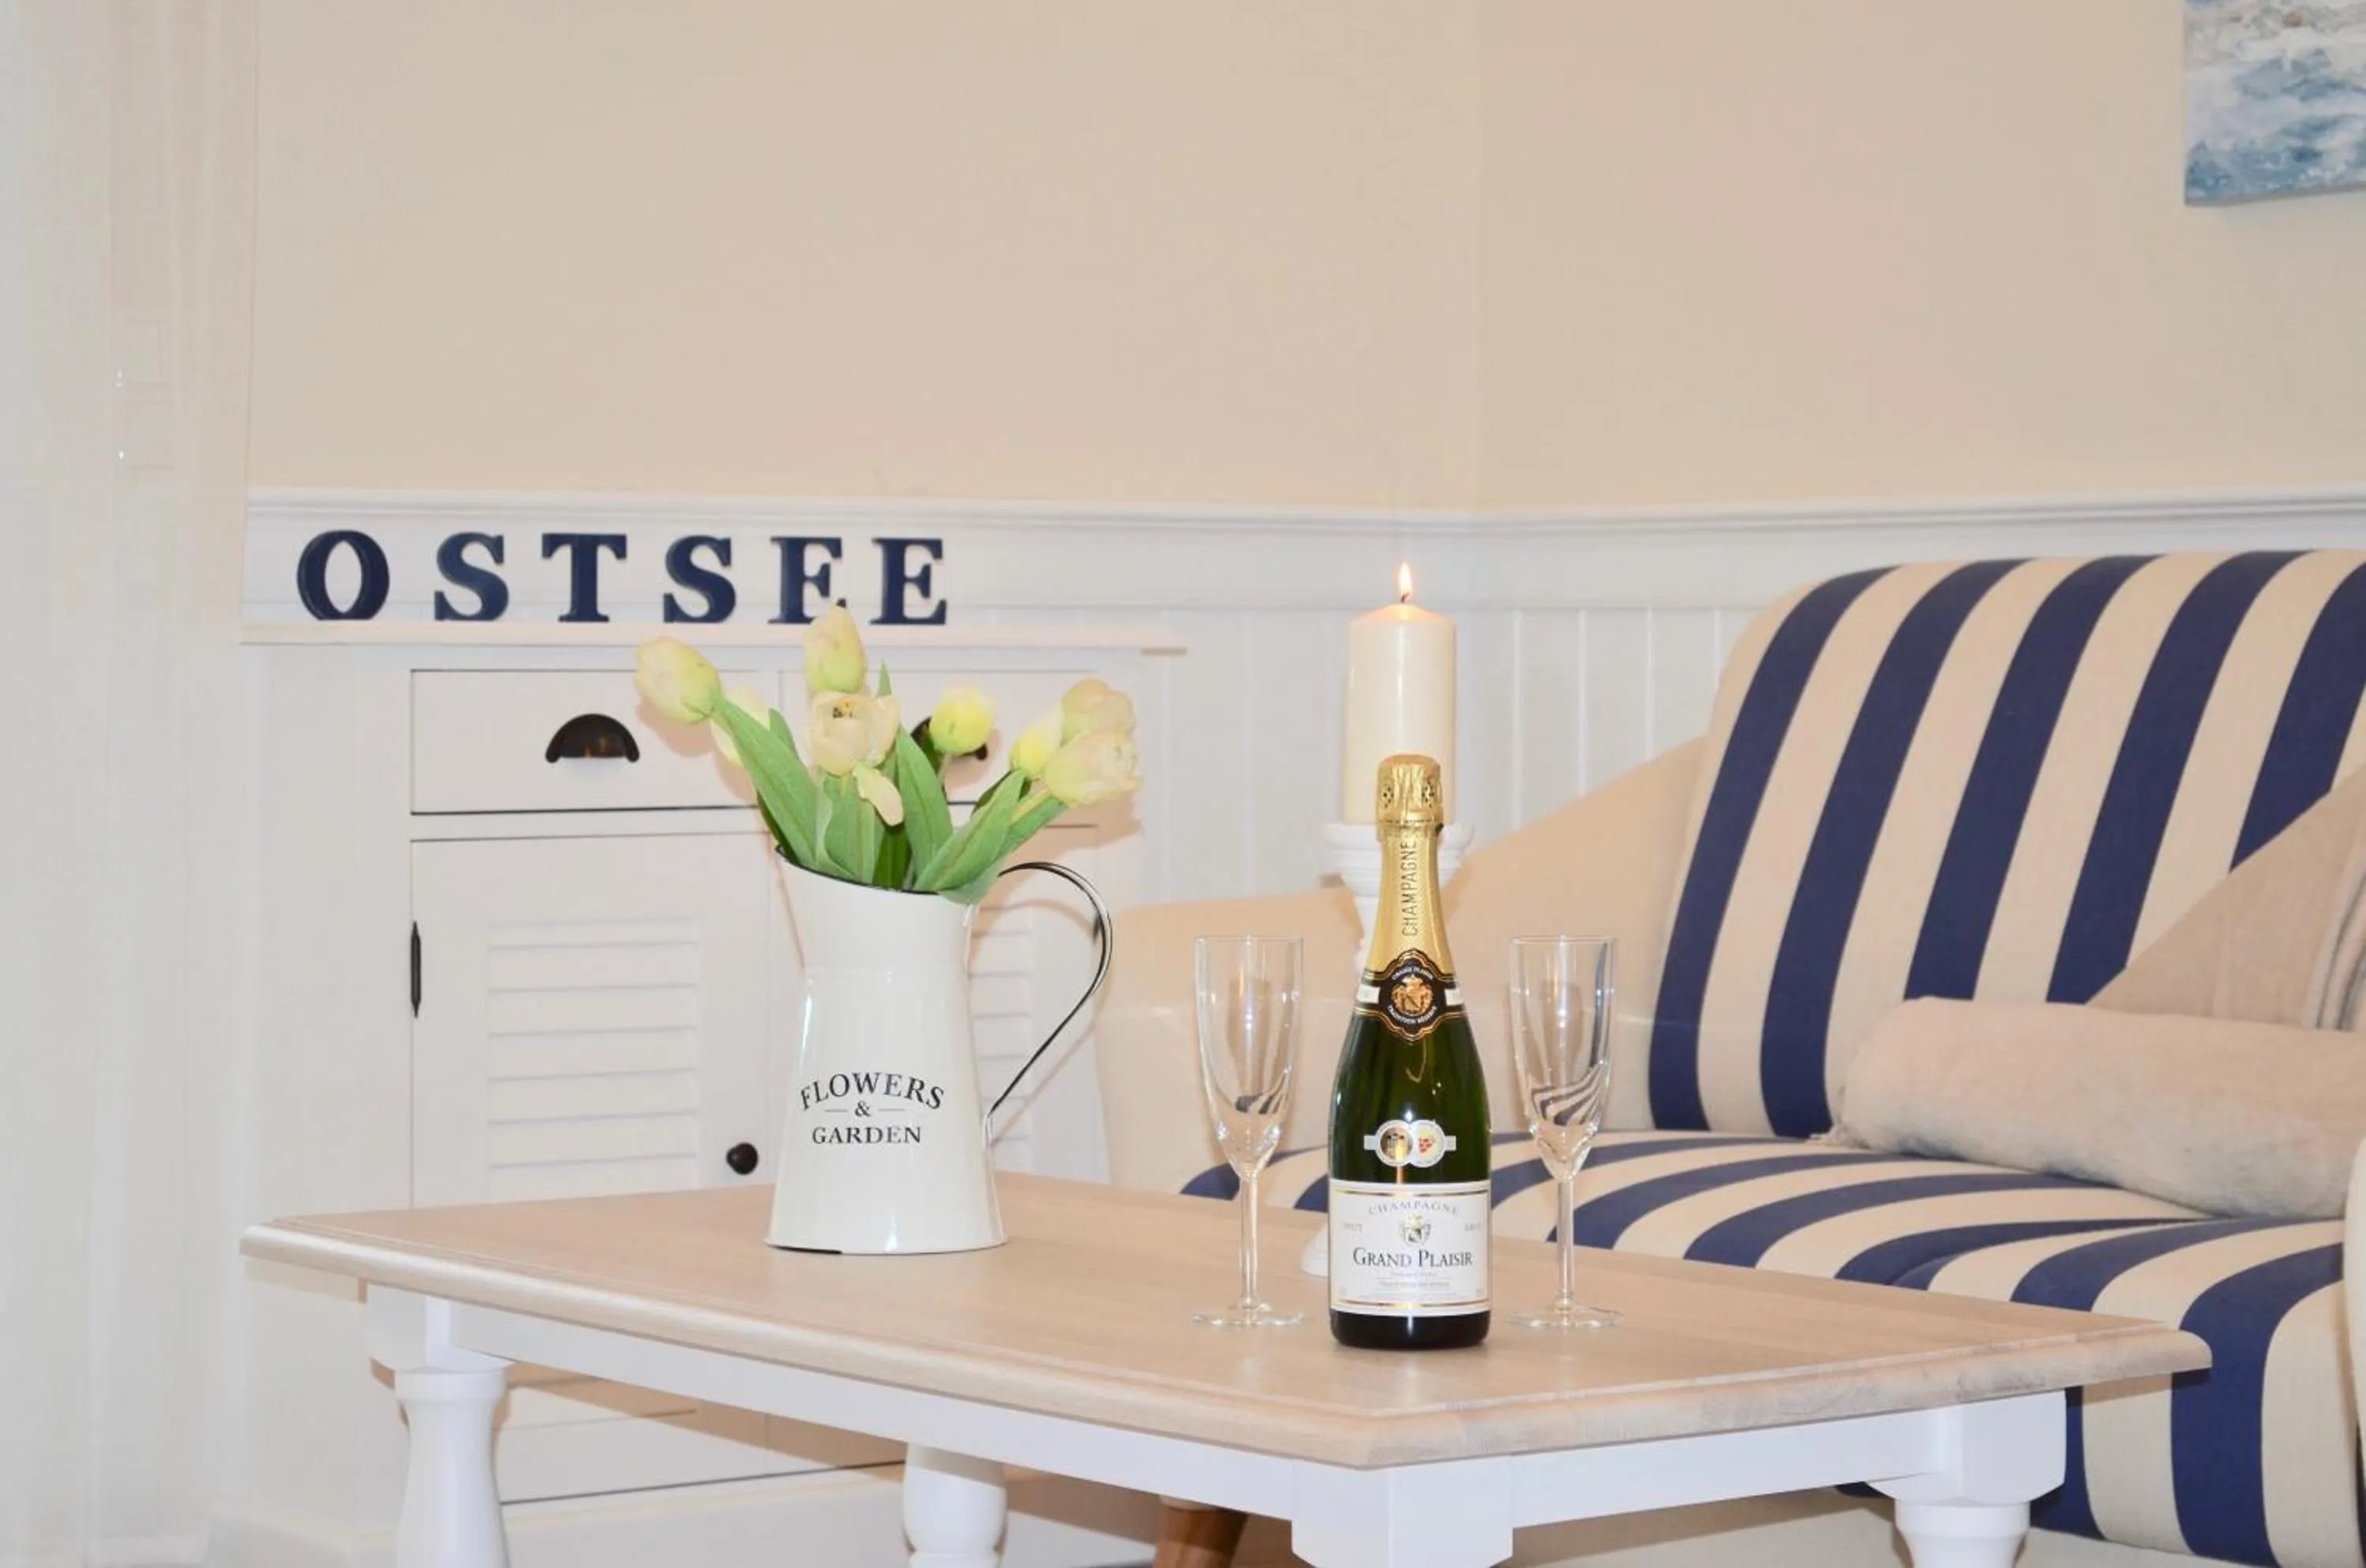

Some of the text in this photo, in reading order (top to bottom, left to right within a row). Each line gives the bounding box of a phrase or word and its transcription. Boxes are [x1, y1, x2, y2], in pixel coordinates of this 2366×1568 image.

[297, 530, 947, 625] OSTSEE
[1401, 842, 1418, 936] CHAMPAGNE
[800, 1072, 944, 1111] FLOWERS
[854, 1100, 871, 1117] &
[812, 1126, 922, 1144] GARDEN
[1368, 1200, 1461, 1216] CHAMPAGNE
[1353, 1247, 1473, 1267] GRAND PLAISIR
